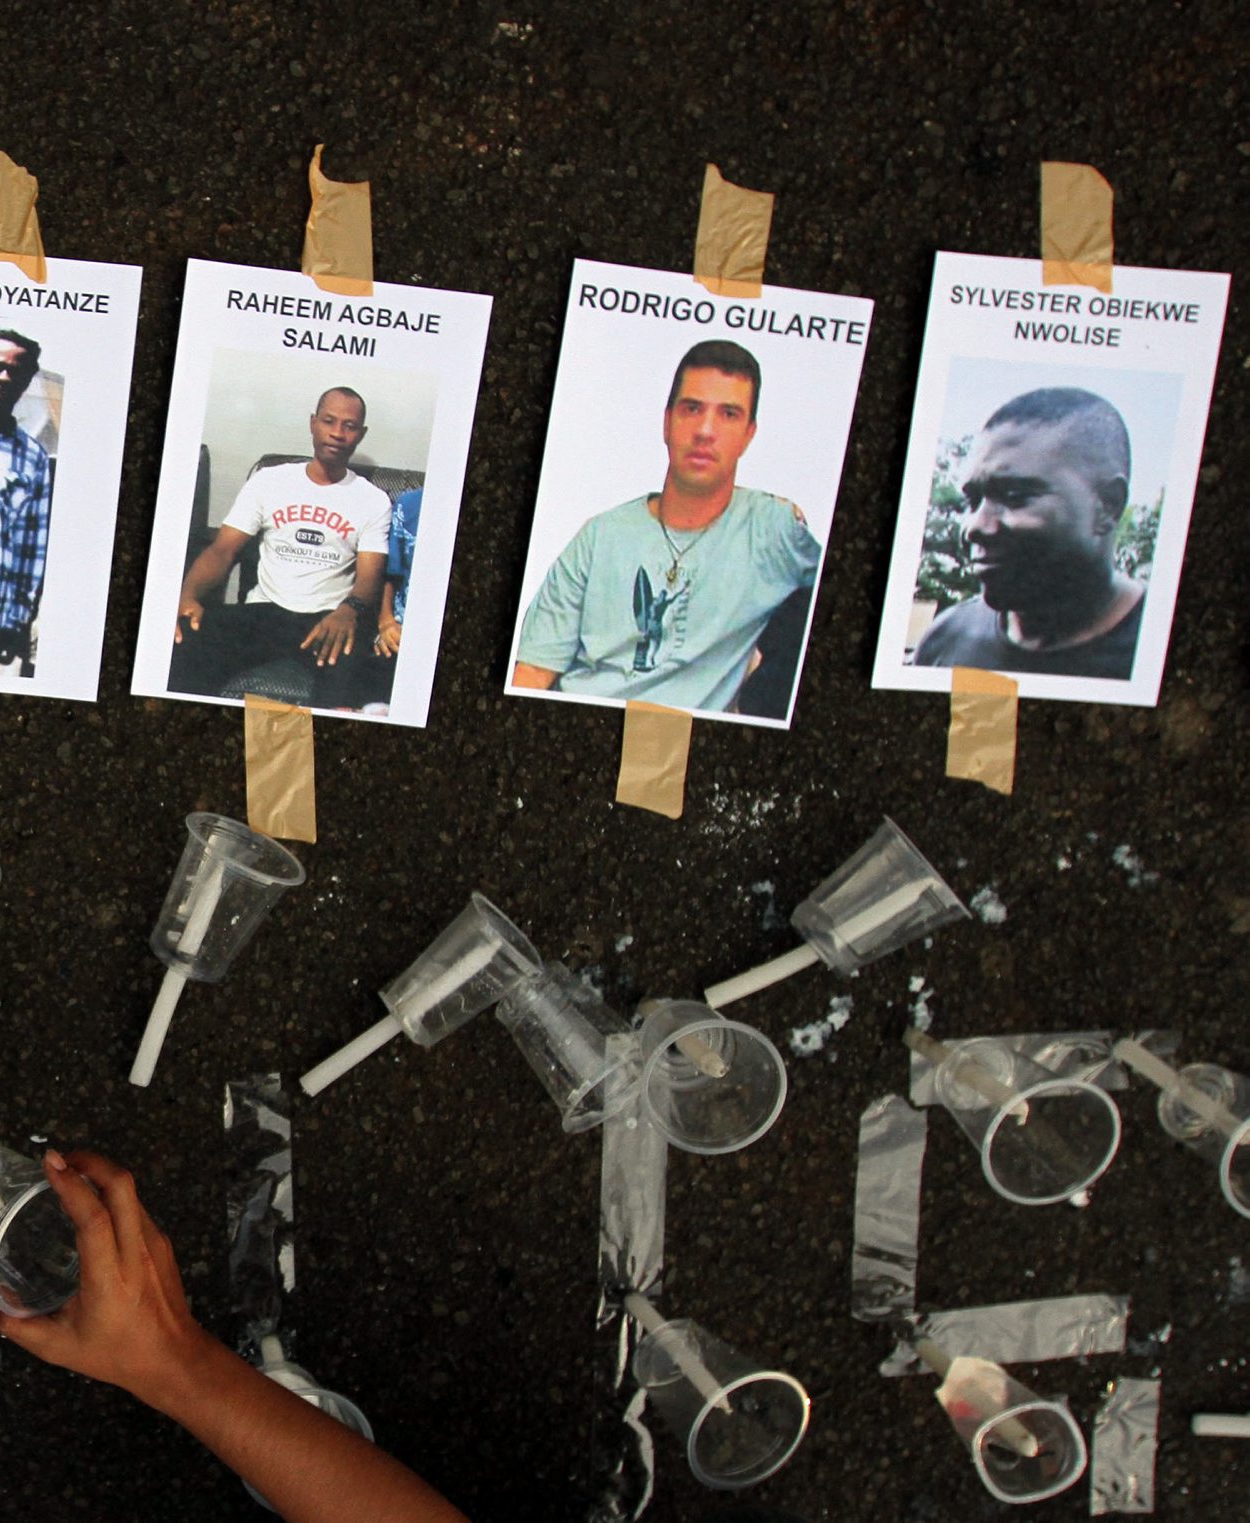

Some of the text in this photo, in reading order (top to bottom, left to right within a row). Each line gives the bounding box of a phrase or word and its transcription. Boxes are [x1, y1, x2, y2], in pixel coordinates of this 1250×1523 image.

[227, 289, 441, 334] RAHEEM AGBAJE
[579, 283, 866, 345] RODRIGO GULARTE
[950, 285, 1199, 323] SYLVESTER OBIEKWE
[282, 328, 377, 357] SALAMI
[1014, 321, 1120, 347] NWOLISE
[272, 504, 356, 541] REEBOK
